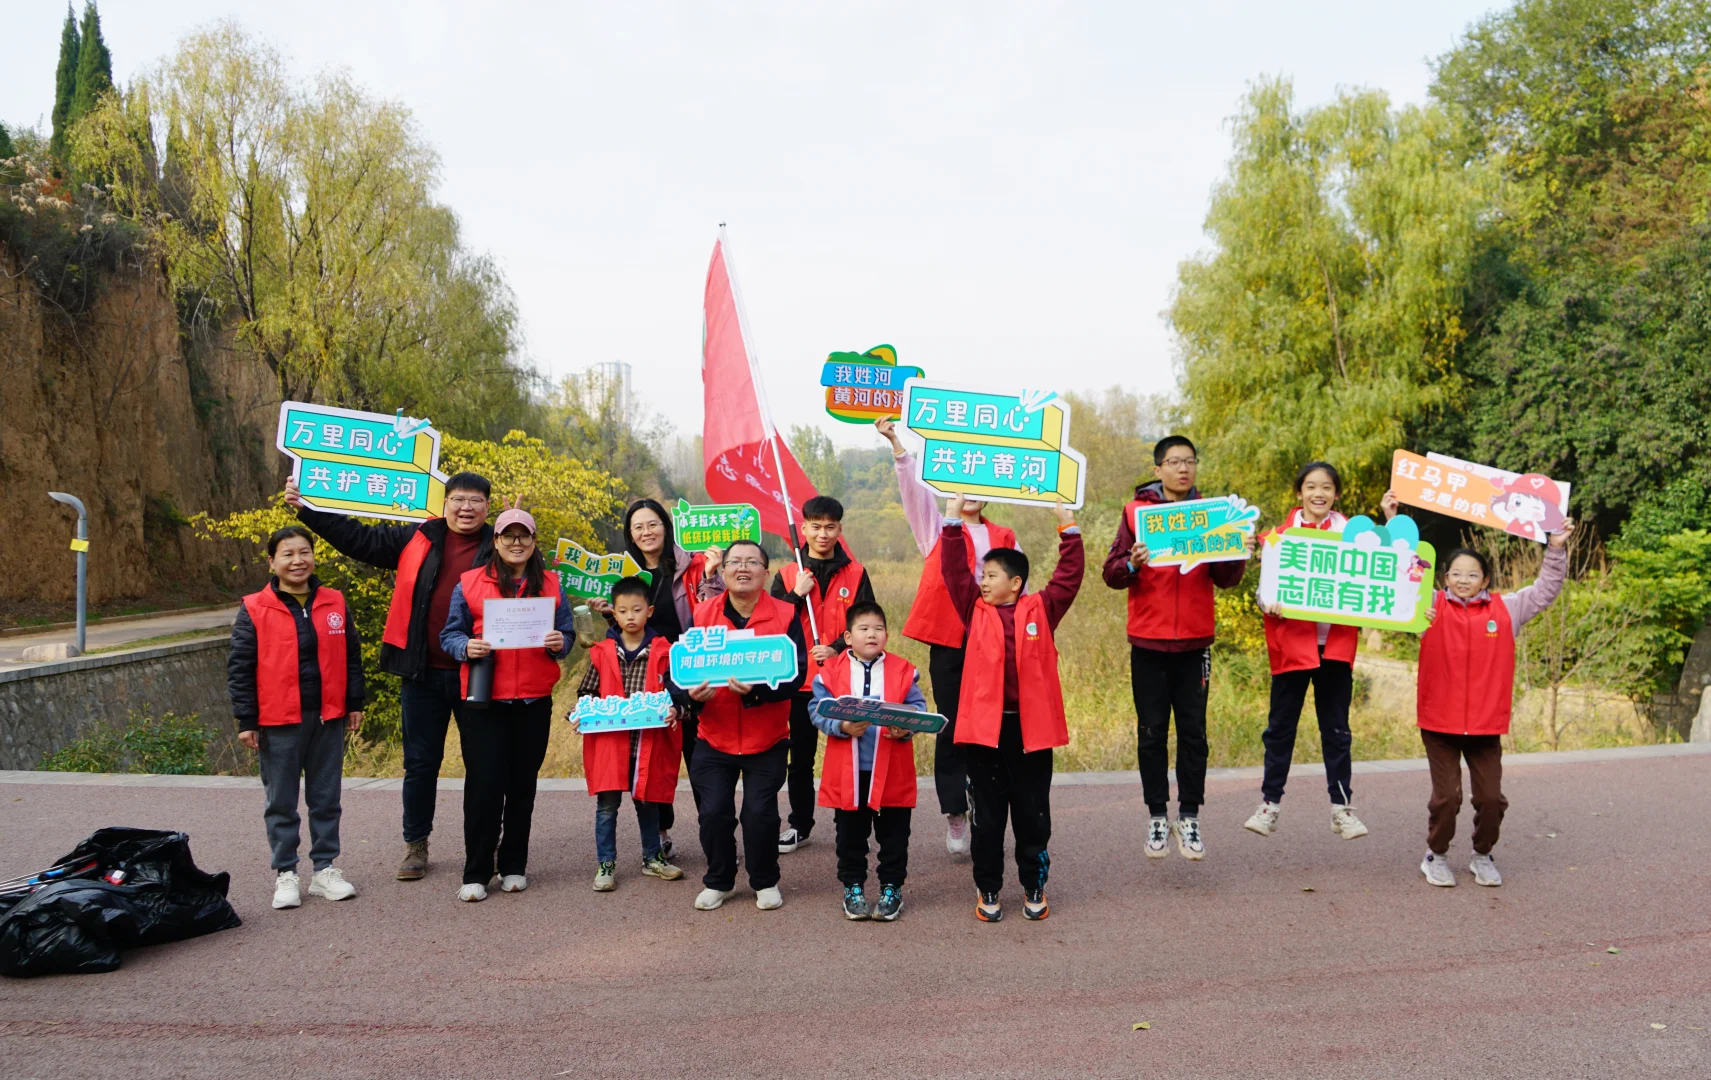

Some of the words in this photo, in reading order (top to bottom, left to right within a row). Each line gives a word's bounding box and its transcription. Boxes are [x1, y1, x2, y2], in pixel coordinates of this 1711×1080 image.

[835, 365, 892, 386] 我姓河
[914, 397, 1030, 433] 万里同心
[291, 420, 403, 455] 万里同心
[931, 446, 1047, 482] 共护黄河
[1395, 458, 1468, 492] 红马甲
[306, 466, 418, 501] 共护黄河
[680, 513, 728, 528] 小手拉大手
[1145, 510, 1209, 534] 我姓河
[682, 528, 751, 545] 低碳环保我能行
[1171, 532, 1243, 556] 河南的河
[564, 546, 624, 573] 我姓河
[1279, 540, 1398, 582] 美丽中国
[1277, 574, 1396, 616] 志愿有我
[685, 628, 726, 650] 争当
[680, 649, 783, 669] 河道环境的守护者
[828, 705, 934, 726] 环保理念的传播者
